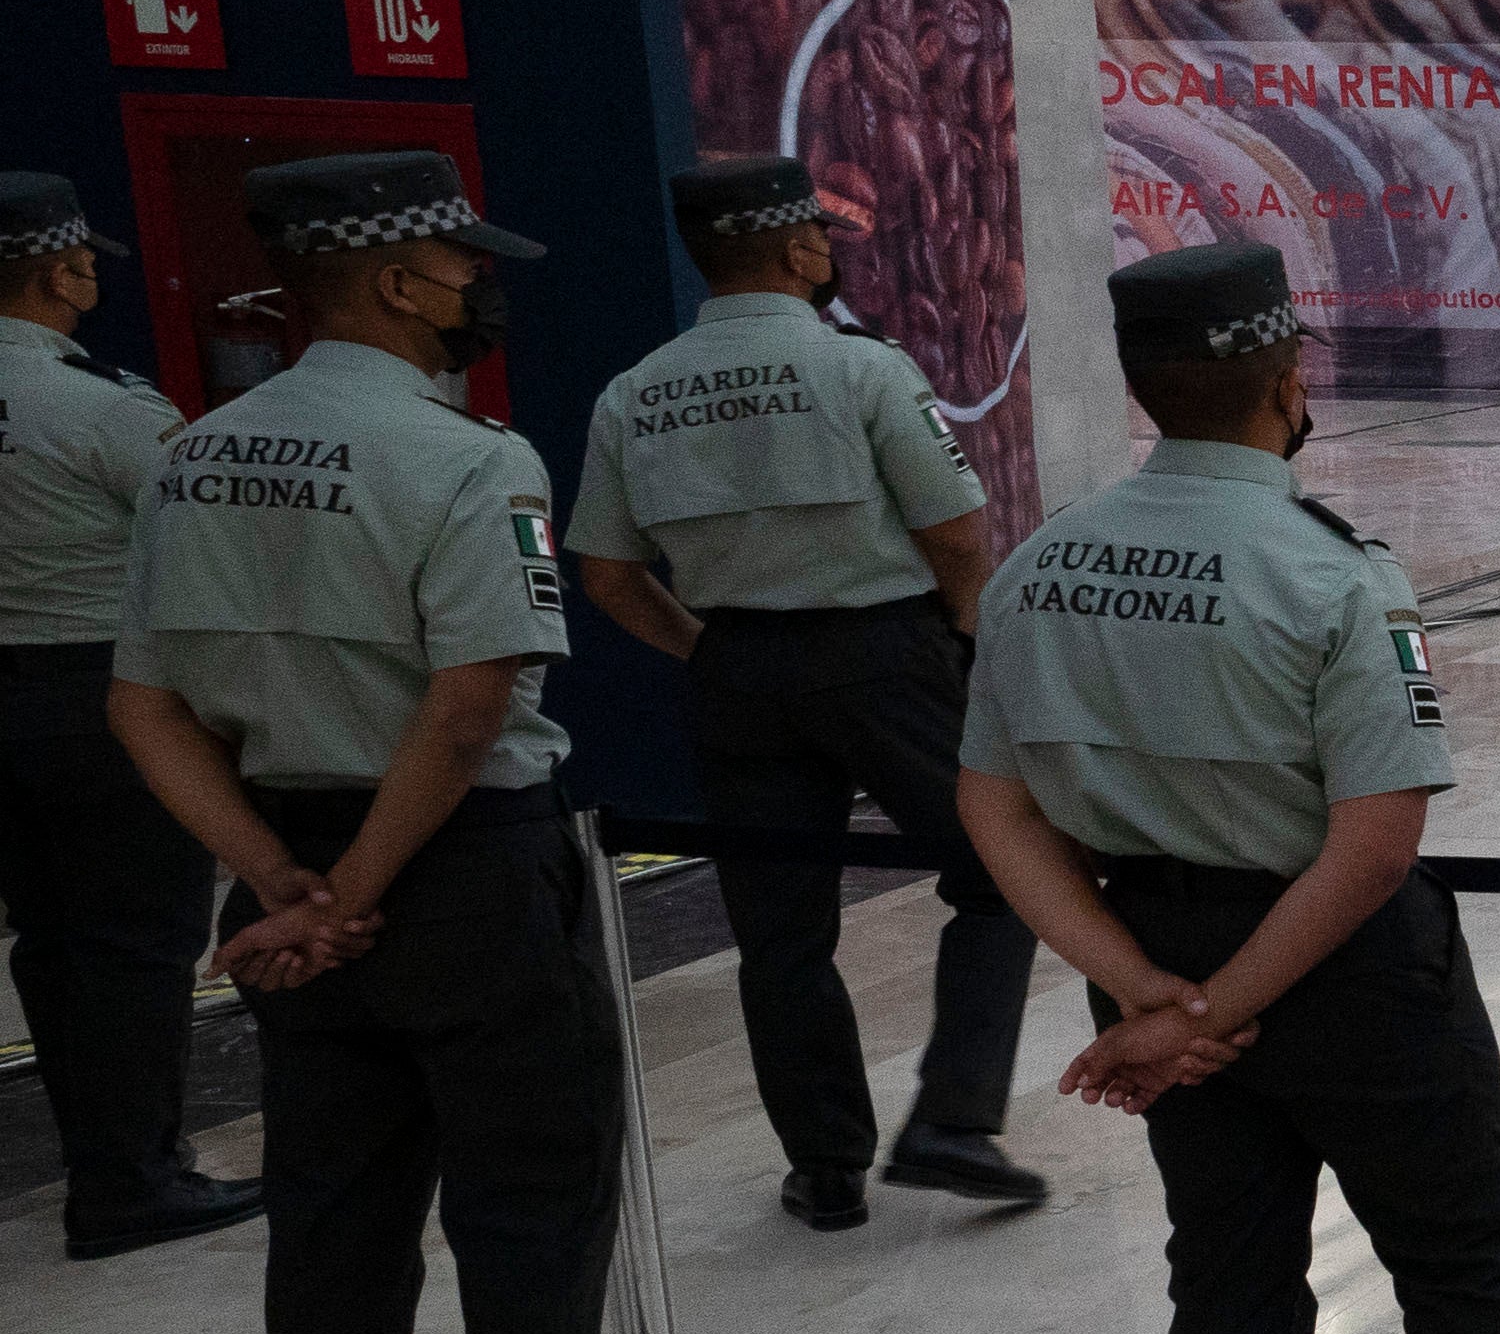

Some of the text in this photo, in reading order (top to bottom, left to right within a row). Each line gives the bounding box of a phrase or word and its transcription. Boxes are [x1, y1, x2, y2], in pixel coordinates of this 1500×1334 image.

[146, 43, 191, 55] EXTINTOR
[387, 53, 435, 65] HIDRANTE
[1100, 61, 1237, 107] OCAL
[1253, 65, 1317, 108] EN
[1111, 182, 1468, 221] AIFA S.A. de C.V.
[640, 364, 800, 407] GUARDIA
[633, 392, 812, 438] NACIONAL
[171, 433, 353, 473] GUARDIA
[1037, 541, 1225, 584] GUARDIA
[1017, 581, 1226, 627] NACIONAL
